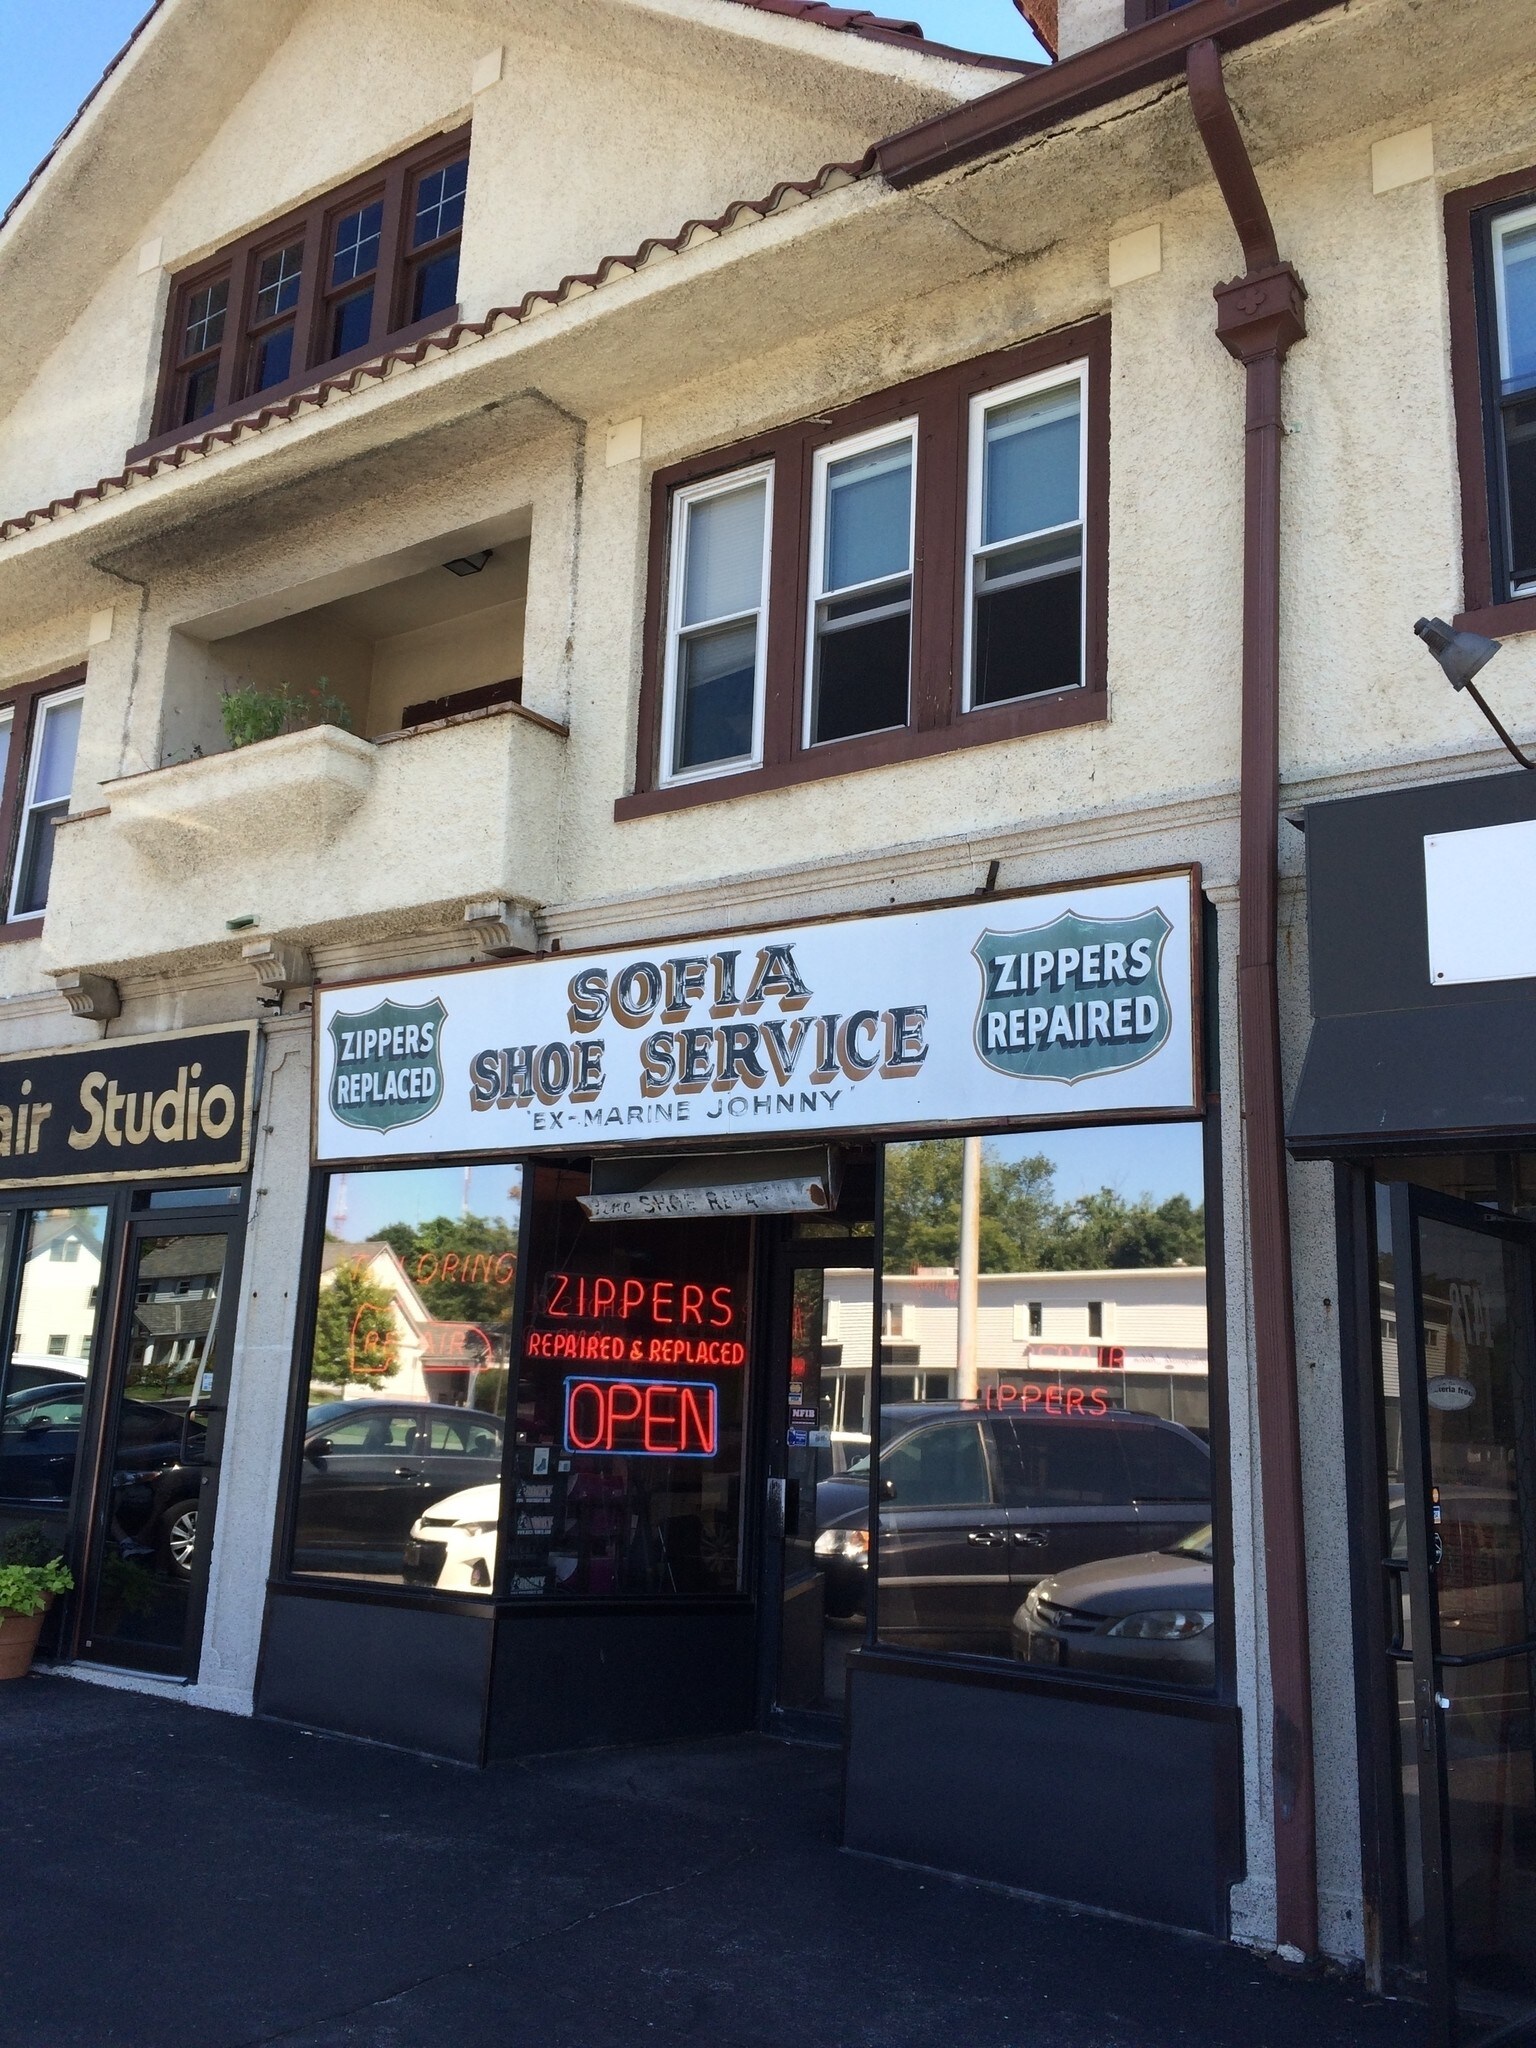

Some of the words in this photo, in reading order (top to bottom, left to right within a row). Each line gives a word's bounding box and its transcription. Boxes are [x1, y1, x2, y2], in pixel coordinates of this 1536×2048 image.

[568, 942, 814, 1034] SOFIA
[986, 937, 1154, 999] ZIPPERS
[338, 1021, 435, 1065] ZIPPERS
[982, 995, 1160, 1055] REPAIRED
[336, 1066, 437, 1109] REPLACED
[469, 1038, 607, 1112] SHOE
[640, 1004, 930, 1099] SERVICE
[68, 1062, 236, 1150] Studio
[548, 1275, 733, 1327] ZIPPERS
[363, 1330, 467, 1356] REAIR
[528, 1332, 626, 1361] REPAIRED
[629, 1339, 644, 1361] &
[649, 1338, 746, 1366] REPLACED
[568, 1382, 716, 1454] OPEN
